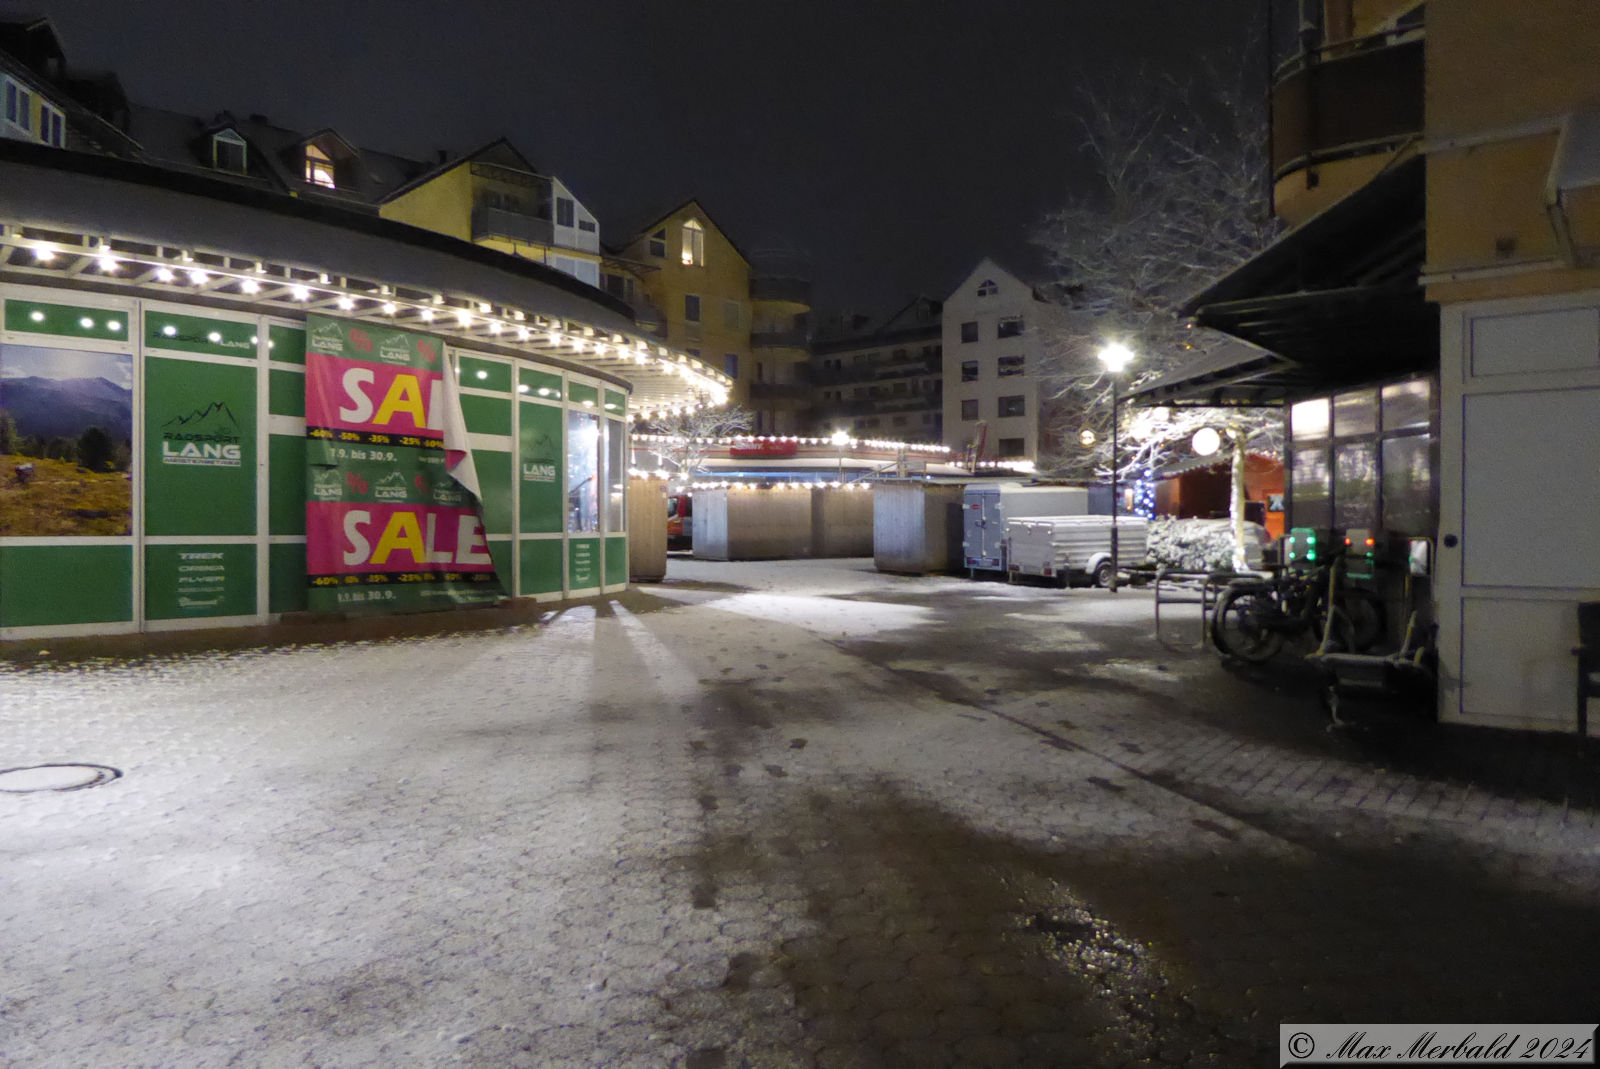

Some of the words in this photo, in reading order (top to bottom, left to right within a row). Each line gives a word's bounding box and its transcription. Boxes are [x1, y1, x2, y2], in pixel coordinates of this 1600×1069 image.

[163, 440, 241, 459] LANG
[352, 449, 366, 460] bis
[370, 450, 397, 462] 30.9.
[523, 463, 556, 477] LANG
[343, 509, 492, 566] SALE
